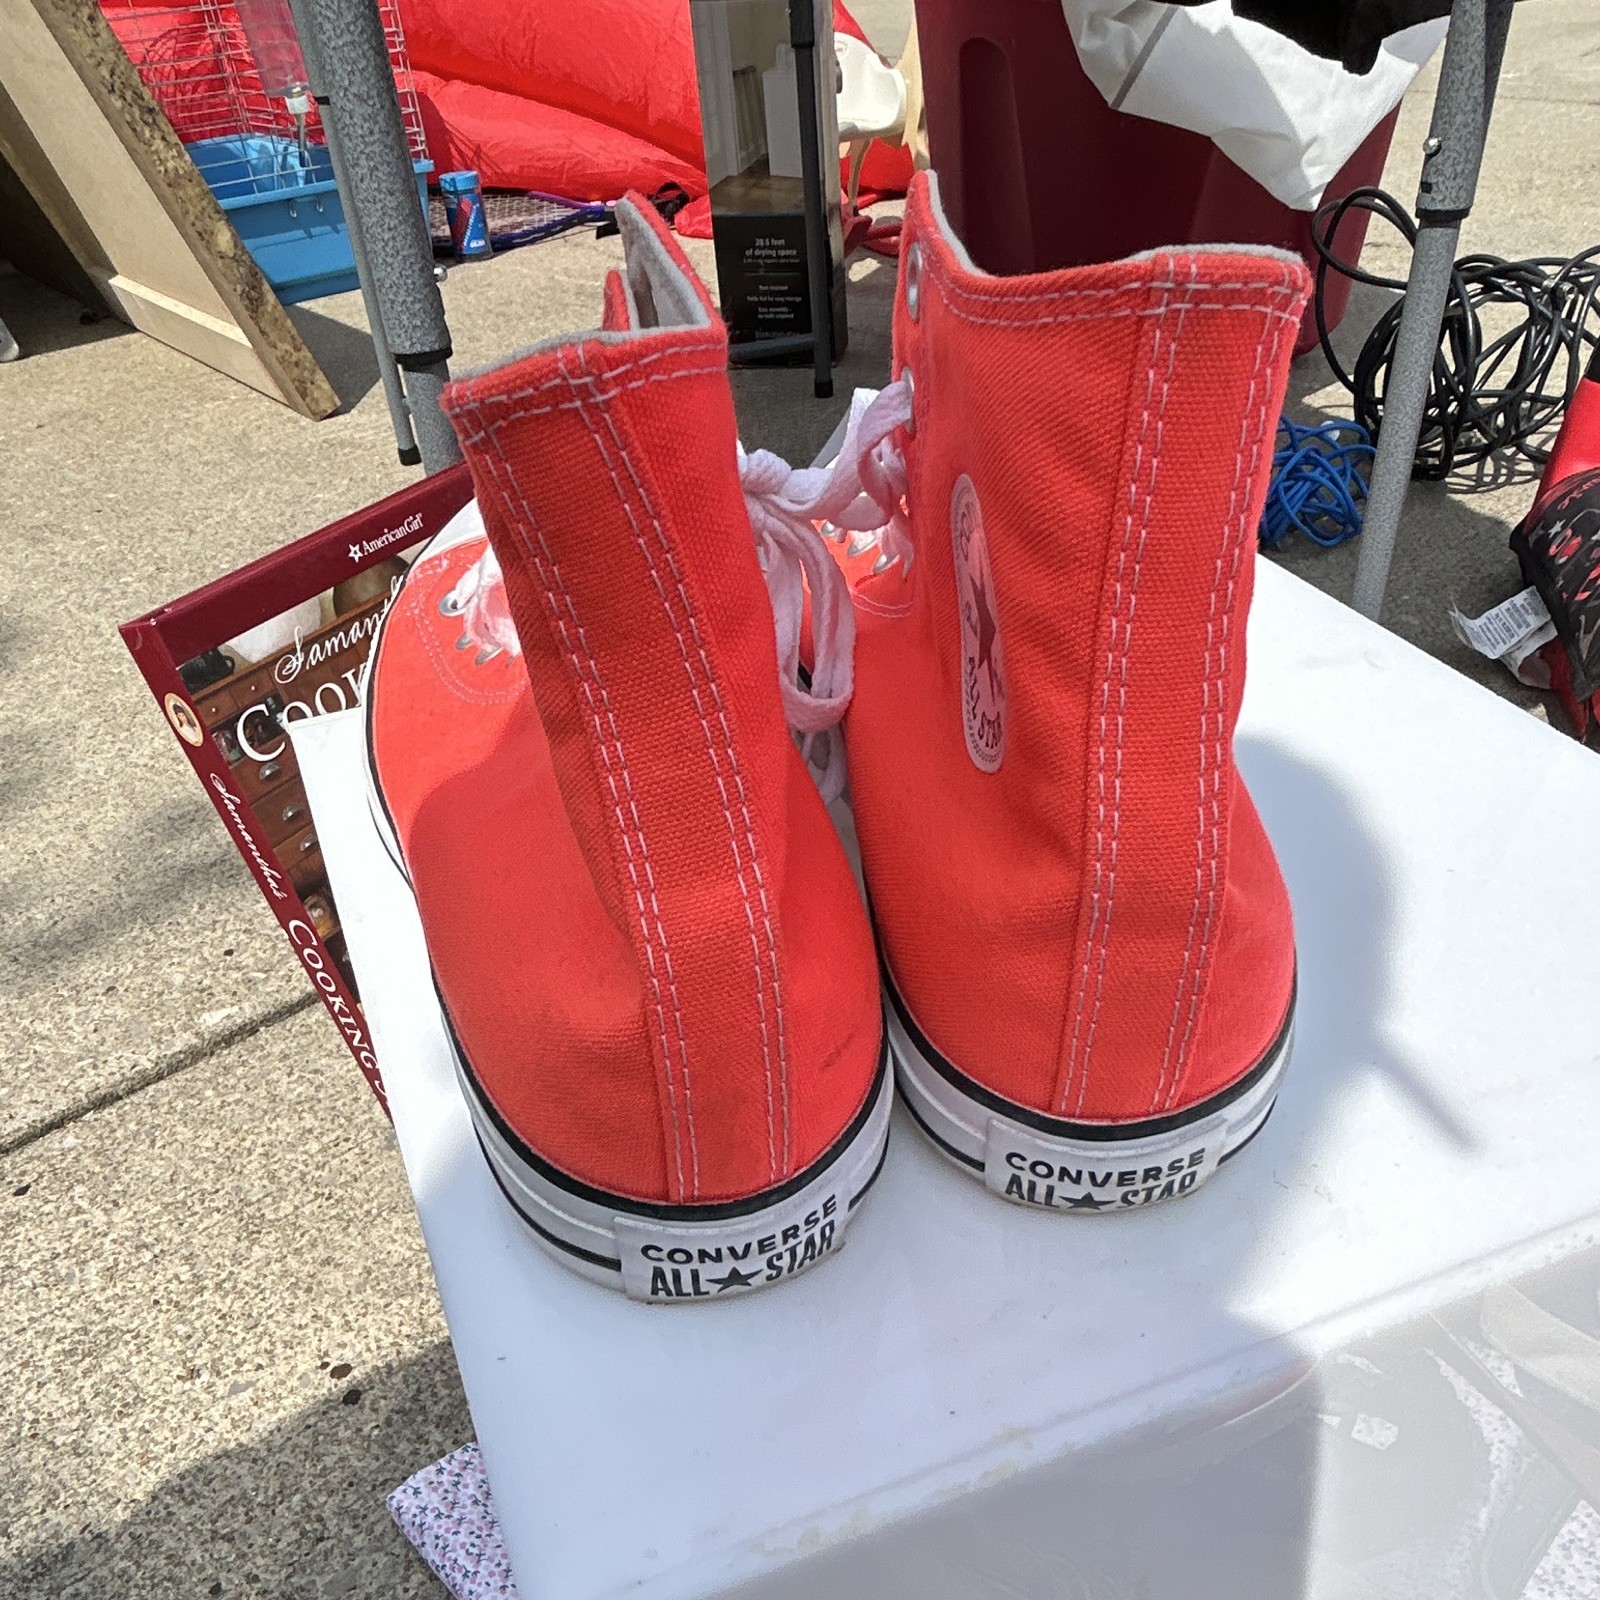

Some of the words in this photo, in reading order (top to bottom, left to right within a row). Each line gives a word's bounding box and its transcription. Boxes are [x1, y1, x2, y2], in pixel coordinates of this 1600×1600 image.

[288, 919, 380, 1069] COOKING
[1005, 1147, 1205, 1188] CONVERSE
[1005, 1173, 1061, 1209] ALL
[1116, 1170, 1197, 1209] STAR
[641, 1193, 837, 1264] CONVERSE
[651, 1266, 710, 1297] ALL
[765, 1219, 835, 1282] STAR
